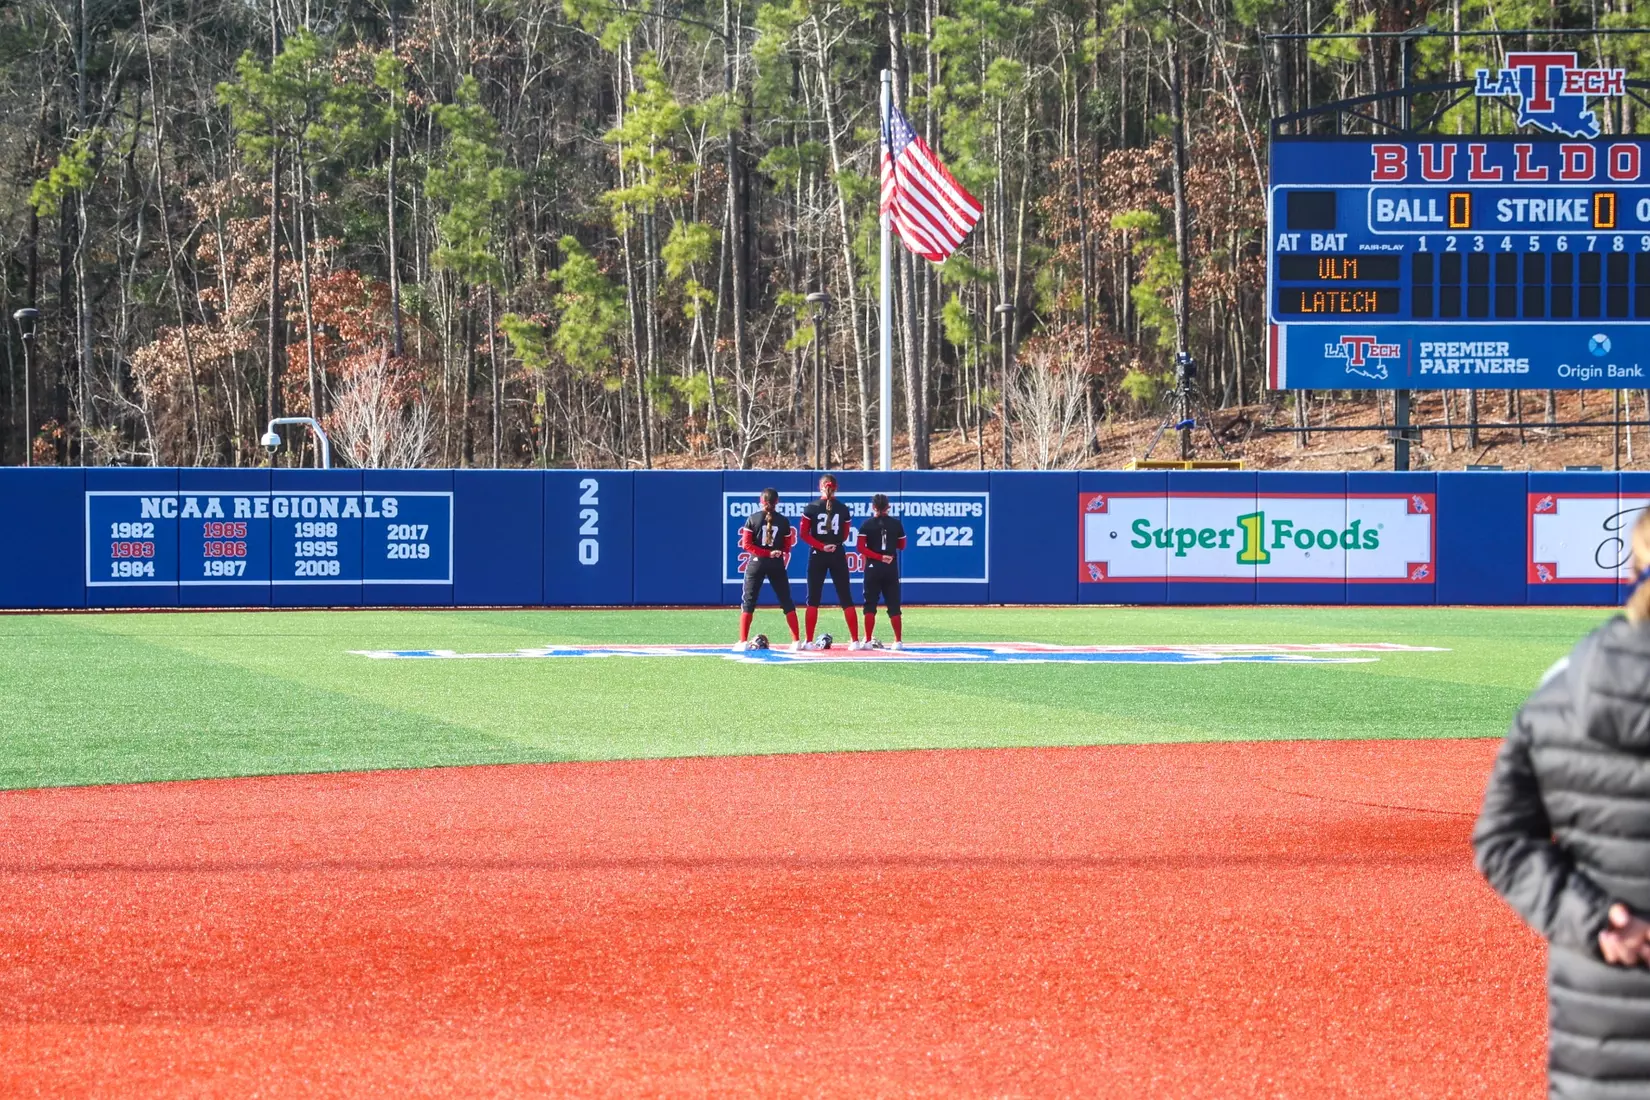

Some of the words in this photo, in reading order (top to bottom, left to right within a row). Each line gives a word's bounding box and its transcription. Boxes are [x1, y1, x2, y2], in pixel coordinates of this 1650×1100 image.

[1371, 143, 1641, 181] BULLDO
[1376, 198, 1443, 222] BALL
[1450, 193, 1470, 228] 0
[1497, 198, 1589, 223] STRIKE
[1594, 193, 1615, 228] 0
[1276, 233, 1301, 251] AT
[1311, 233, 1348, 251] BAT
[1418, 236, 1427, 251] 1
[1446, 236, 1457, 251] 2
[1473, 236, 1484, 251] 3
[1501, 236, 1512, 251] 4
[1529, 236, 1540, 251] 5
[1556, 236, 1568, 251] 6
[1586, 236, 1597, 251] 7
[1613, 236, 1624, 251] 8
[1641, 236, 1650, 251] 9
[1318, 258, 1357, 279] ULM
[1301, 291, 1377, 312] LATECH
[1420, 342, 1510, 357] PREMIER
[1420, 358, 1529, 374] PARTNERS
[1557, 364, 1603, 381] Origin
[141, 497, 225, 518] NCAA
[233, 497, 398, 518] REGIONALS
[111, 522, 154, 538] 1982
[203, 522, 247, 538] 1985
[295, 522, 338, 538] 1988
[387, 524, 429, 540] 2017
[816, 513, 839, 535] 24
[916, 526, 973, 546] 2022
[1131, 518, 1234, 557] Super
[1236, 510, 1271, 565] 1
[1271, 518, 1380, 550] Foods
[111, 542, 155, 558] 1983
[203, 541, 247, 557] 1986
[295, 541, 338, 557] 1995
[387, 543, 430, 559] 2019
[111, 561, 155, 577] 1984
[203, 560, 247, 576] 1987
[295, 560, 340, 576] 2008
